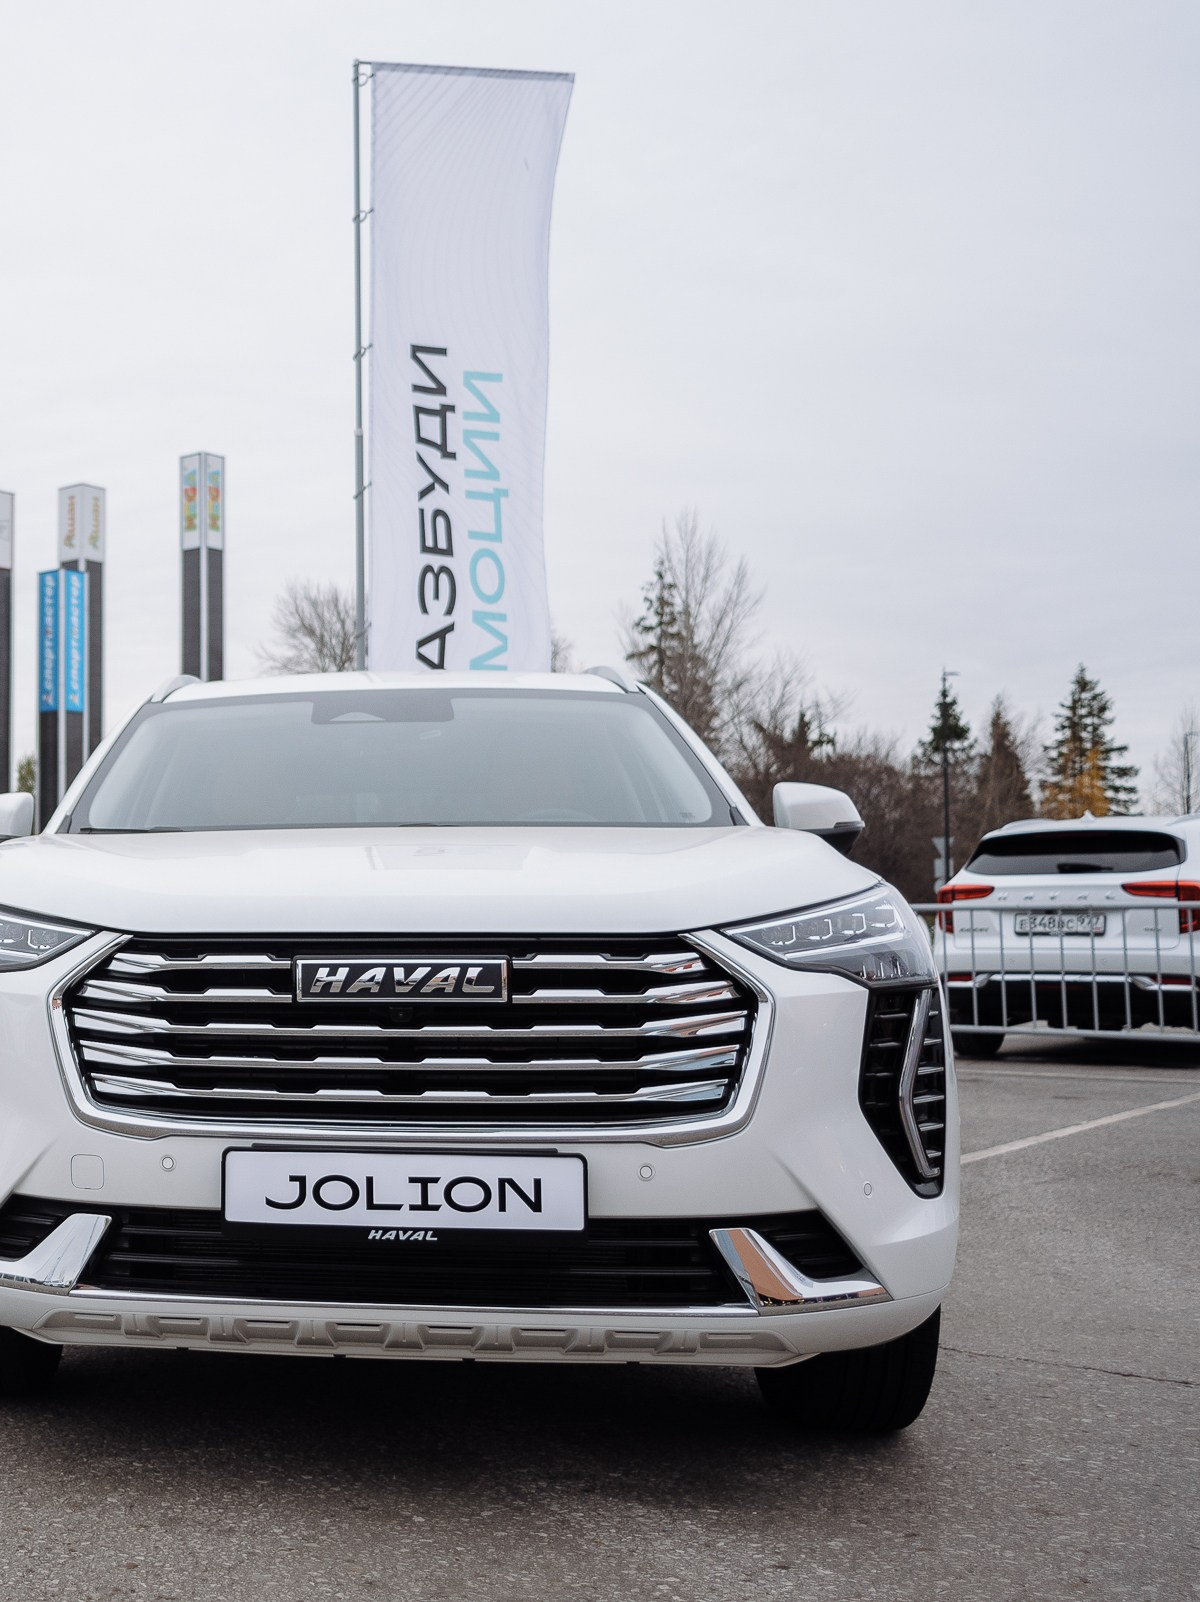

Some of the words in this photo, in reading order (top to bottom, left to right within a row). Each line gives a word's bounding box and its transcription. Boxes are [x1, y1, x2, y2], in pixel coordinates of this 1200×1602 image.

[462, 370, 509, 671] МОЦИИ
[308, 966, 496, 994] HAVAL
[264, 1173, 543, 1214] JOLION
[367, 1229, 439, 1242] HAVAL
